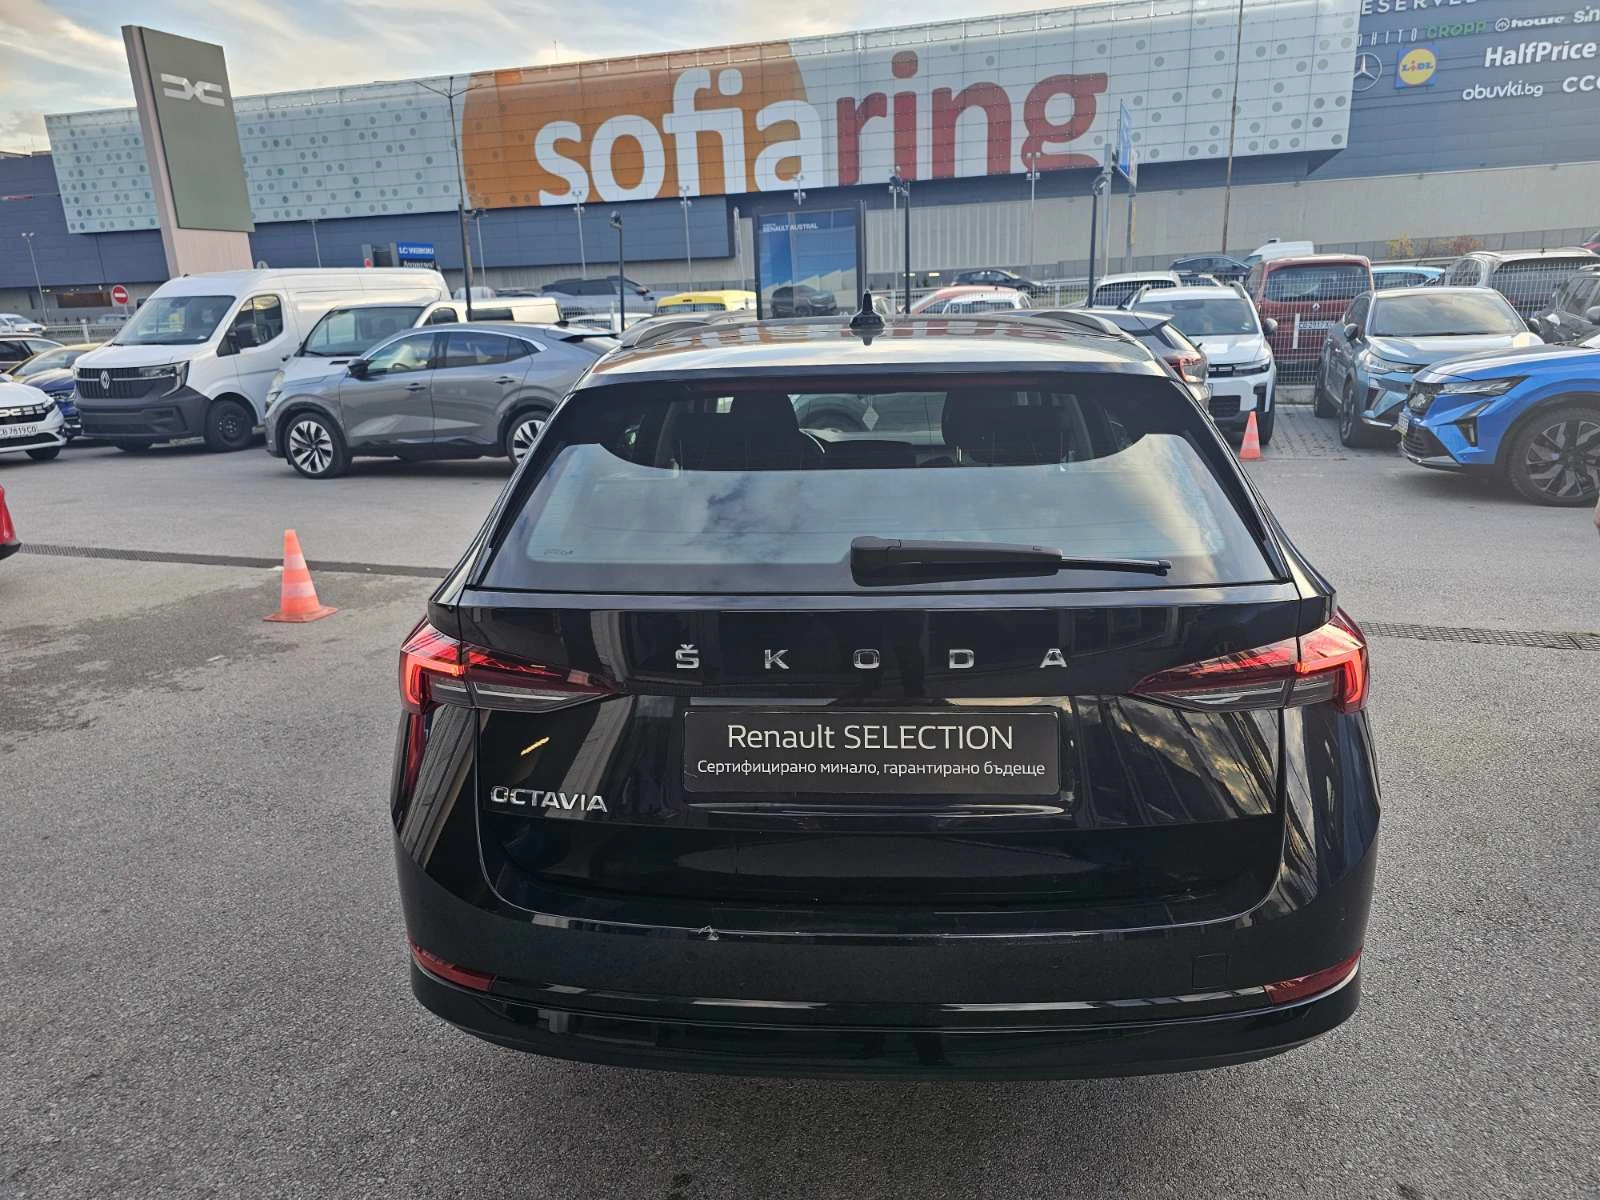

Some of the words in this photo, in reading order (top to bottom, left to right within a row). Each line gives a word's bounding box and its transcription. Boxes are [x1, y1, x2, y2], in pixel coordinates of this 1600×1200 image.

[1361, 0, 1478, 15] ESER
[1484, 40, 1597, 67] HalfPrice
[1462, 80, 1543, 101] obuvki.bg
[1562, 75, 1600, 93] CC
[674, 643, 1068, 670] ŠKODA
[727, 723, 836, 749] Renault
[843, 724, 1013, 750] SELECTION
[697, 759, 817, 776] Сертифицирано
[820, 762, 880, 776] минало,
[883, 763, 980, 778] гарантирано
[983, 761, 1046, 777] бъдеще
[490, 785, 608, 813] OCTAVIA
